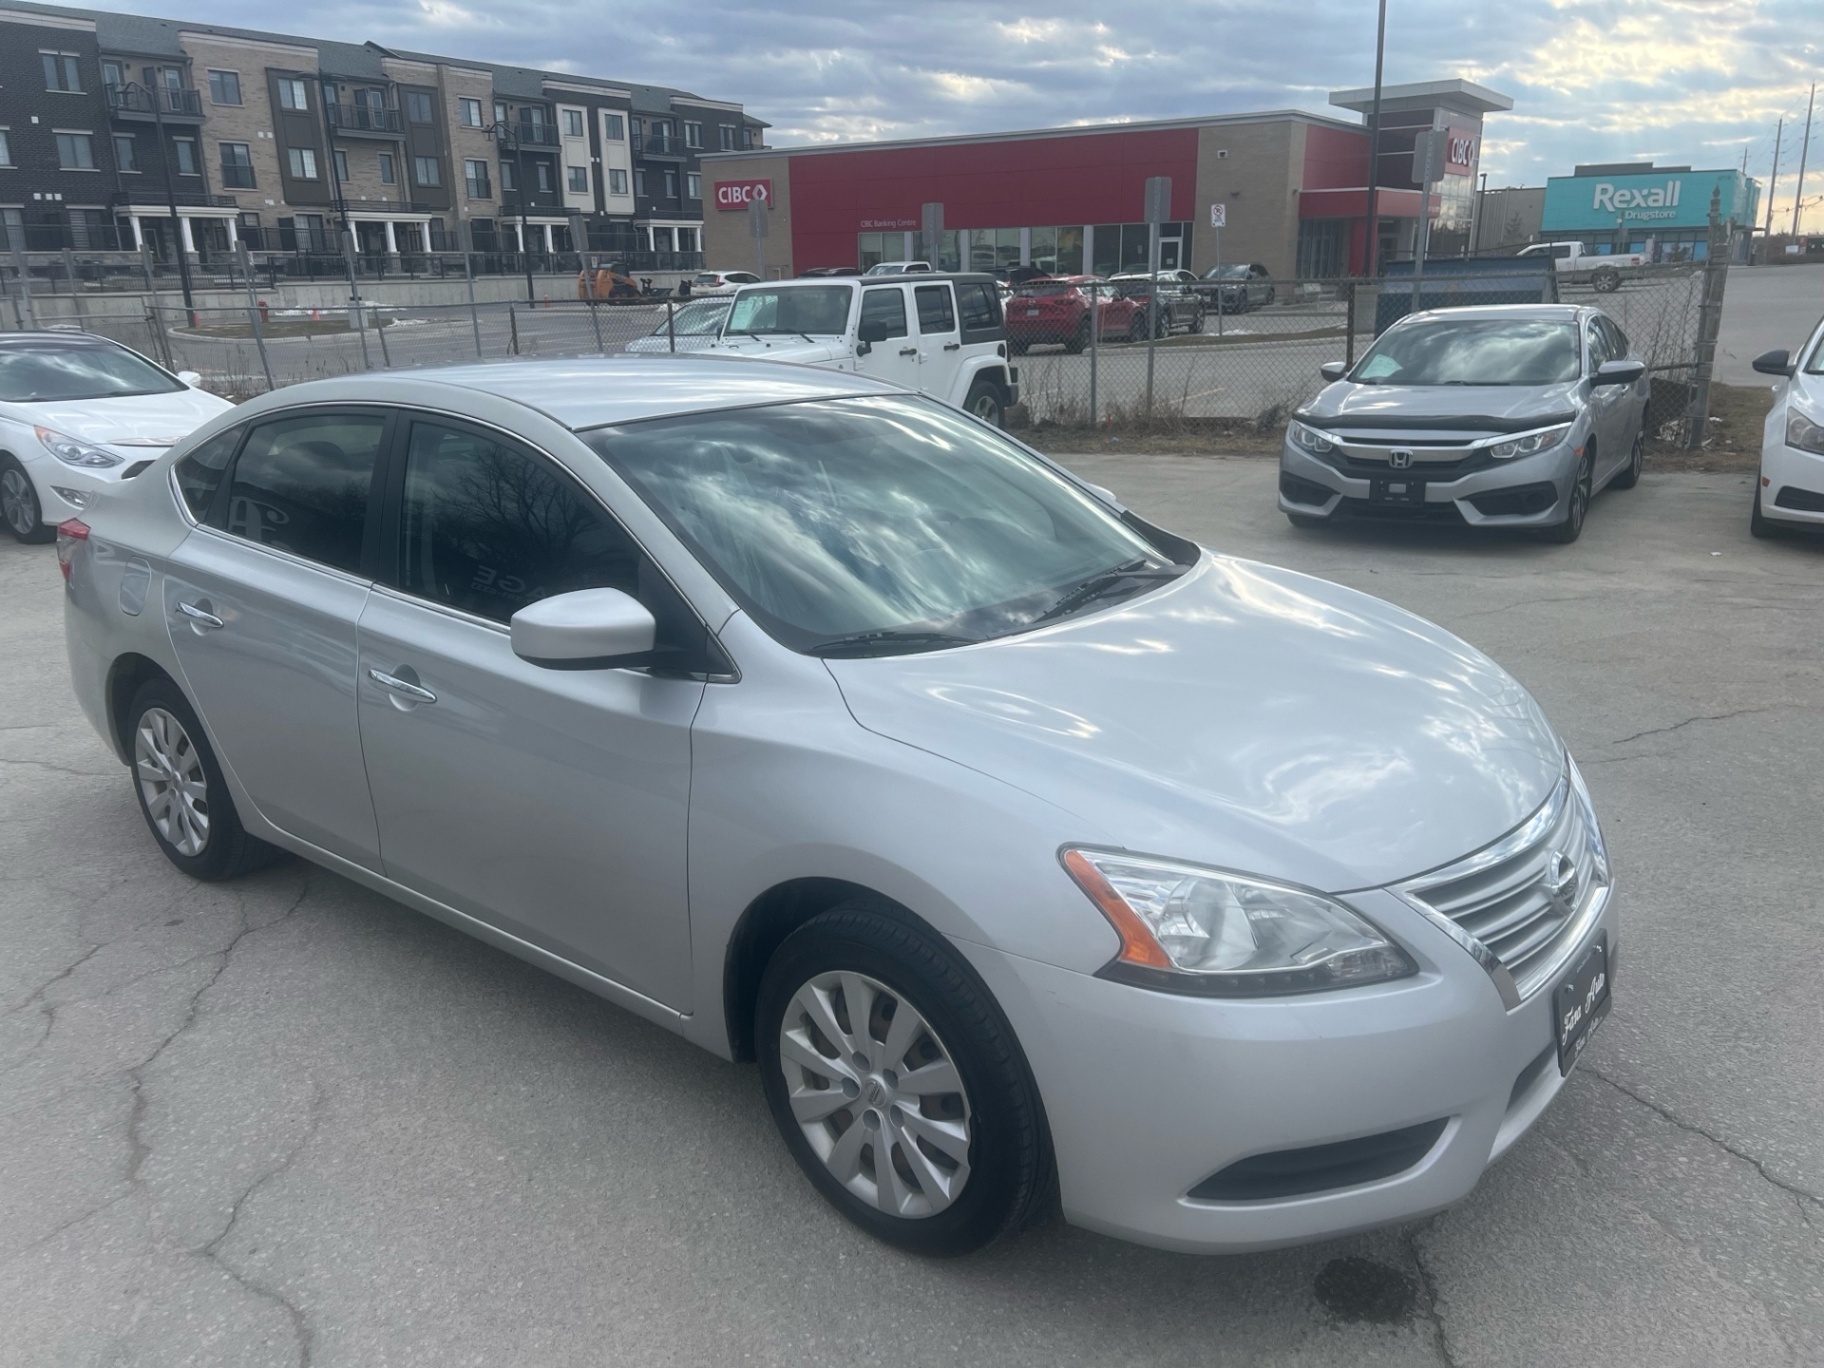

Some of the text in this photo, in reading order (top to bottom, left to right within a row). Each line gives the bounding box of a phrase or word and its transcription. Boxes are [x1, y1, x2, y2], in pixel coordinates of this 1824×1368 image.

[1452, 138, 1470, 166] CIBC
[718, 186, 751, 203] CIBC
[1593, 180, 1681, 212] Rexall
[874, 219, 897, 229] Banking
[897, 218, 917, 226] Centre
[1625, 210, 1676, 221] Drugstore
